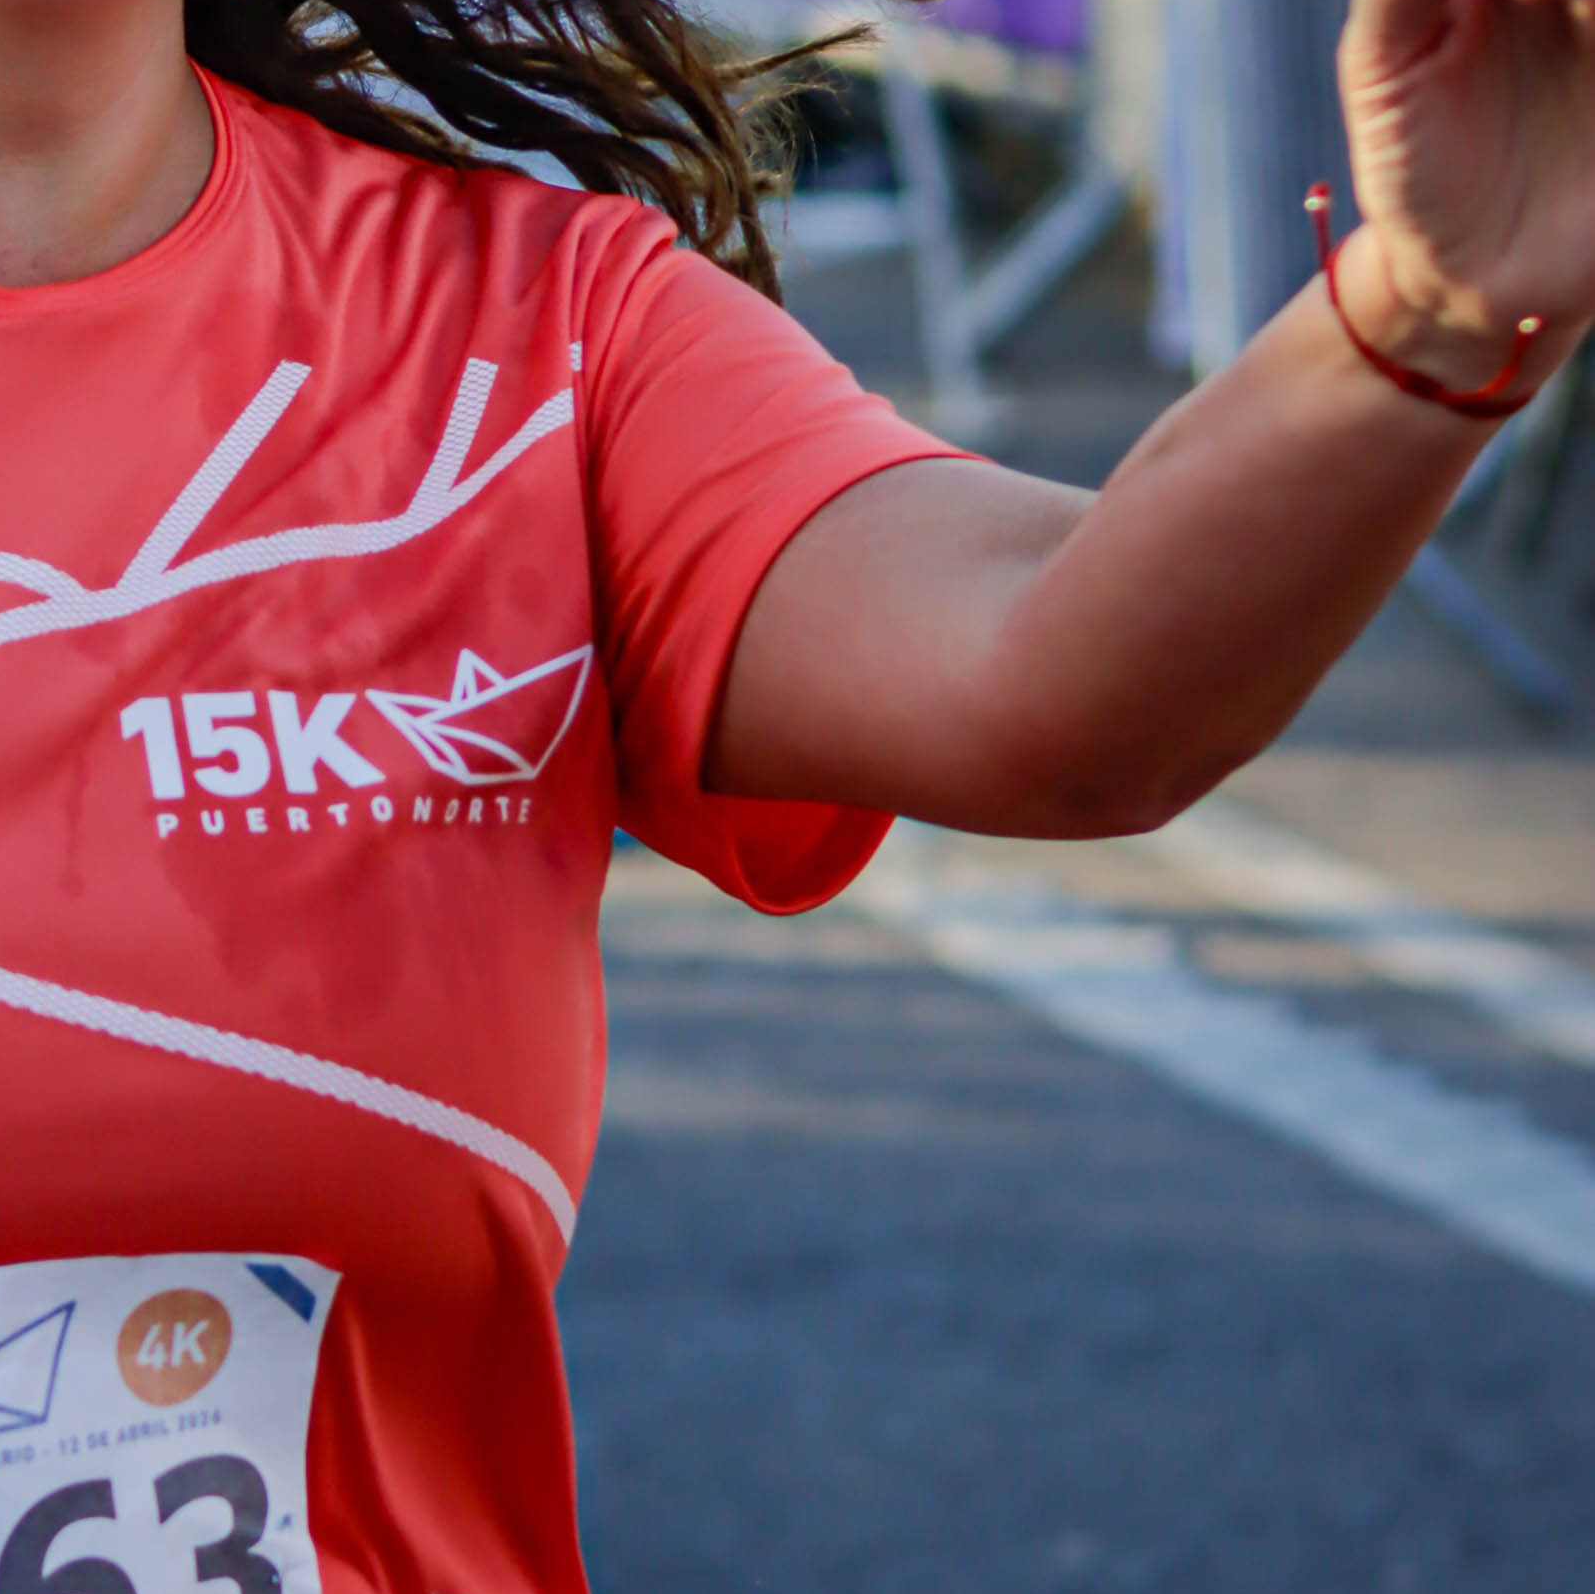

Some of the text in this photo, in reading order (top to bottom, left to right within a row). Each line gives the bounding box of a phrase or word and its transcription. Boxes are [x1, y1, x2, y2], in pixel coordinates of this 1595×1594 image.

[119, 689, 387, 800] 15K
[136, 1319, 211, 1371] 4K
[58, 1434, 80, 1454] 12
[87, 1429, 110, 1450] DE
[116, 1418, 170, 1444] ABRIL
